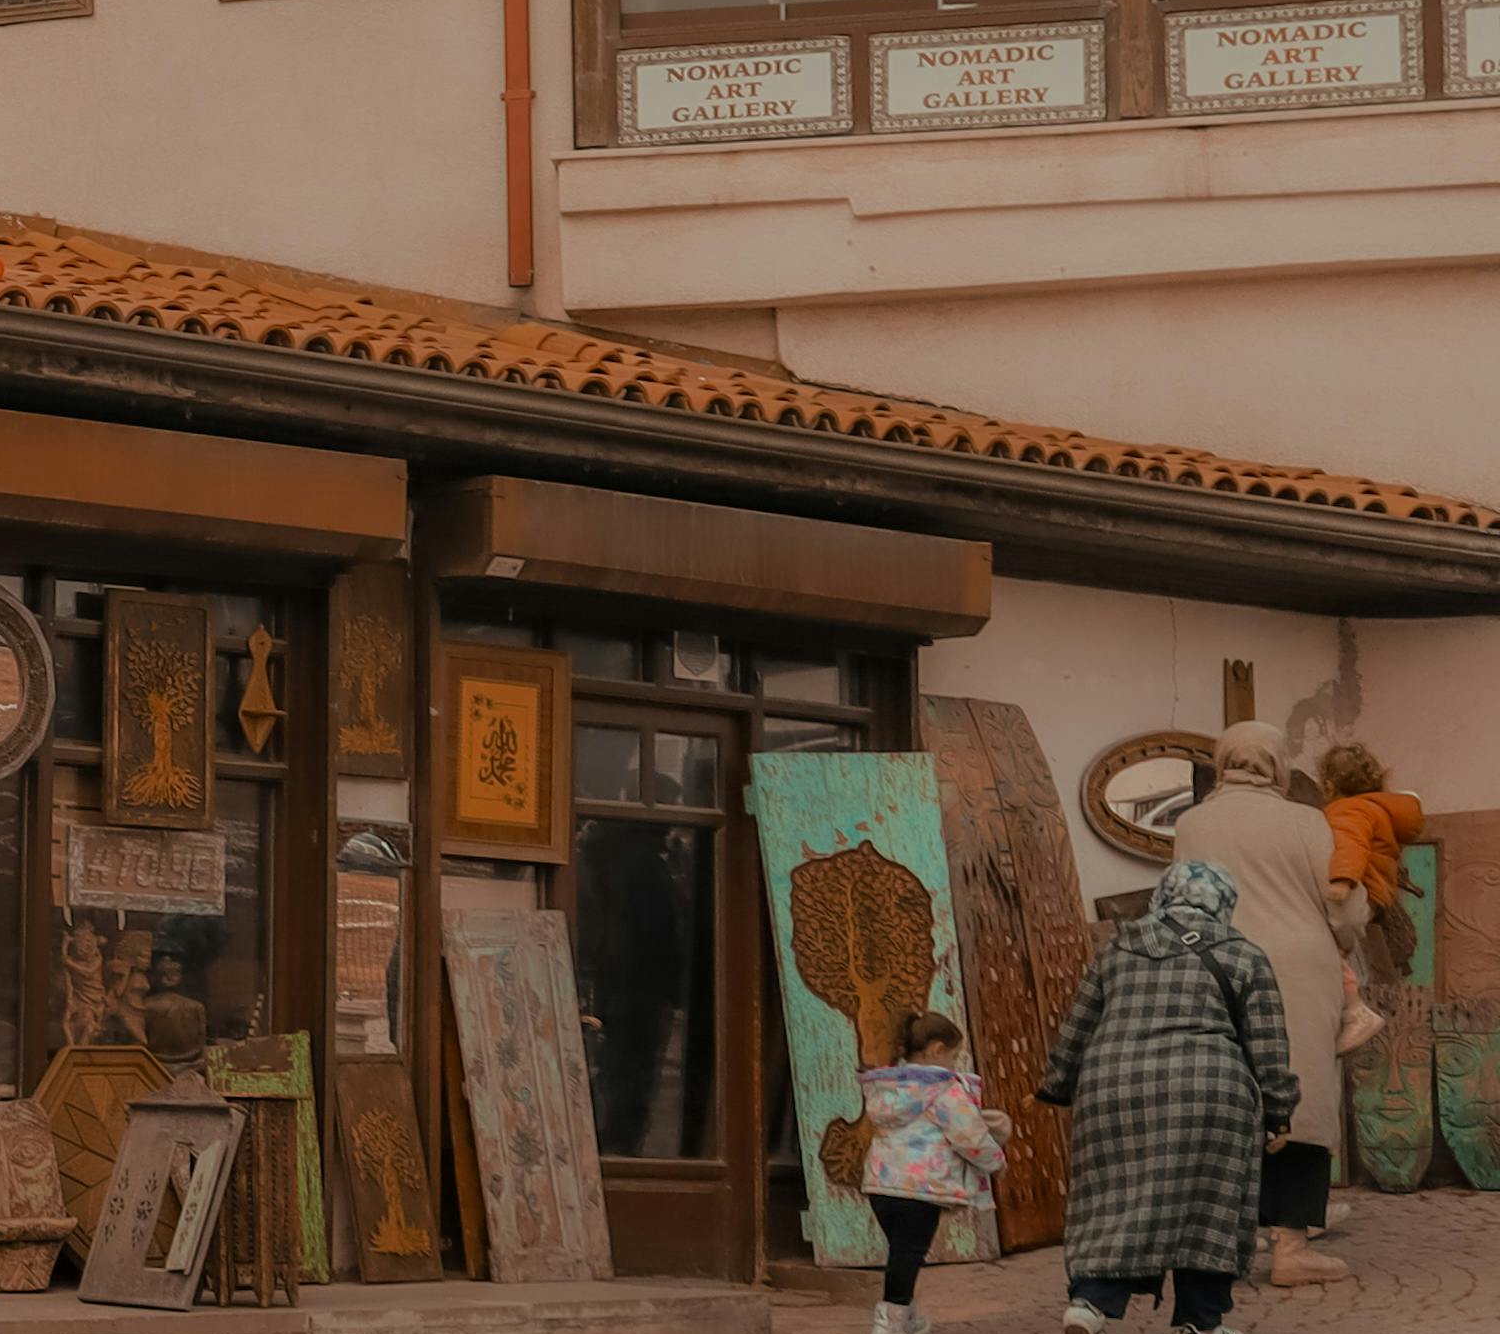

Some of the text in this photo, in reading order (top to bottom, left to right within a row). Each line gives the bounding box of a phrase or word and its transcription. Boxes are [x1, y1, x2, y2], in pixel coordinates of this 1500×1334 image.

[1216, 21, 1368, 48] NOMADIC
[917, 44, 1055, 68] NOMADIC
[1261, 47, 1324, 66] ART
[1481, 58, 1500, 75] 0
[665, 58, 802, 83] NOMADIC
[957, 68, 1015, 86] ART
[1224, 65, 1363, 91] GALLERY
[706, 81, 762, 100] ART
[923, 87, 1050, 110] GALLERY
[671, 100, 797, 123] GALLERY
